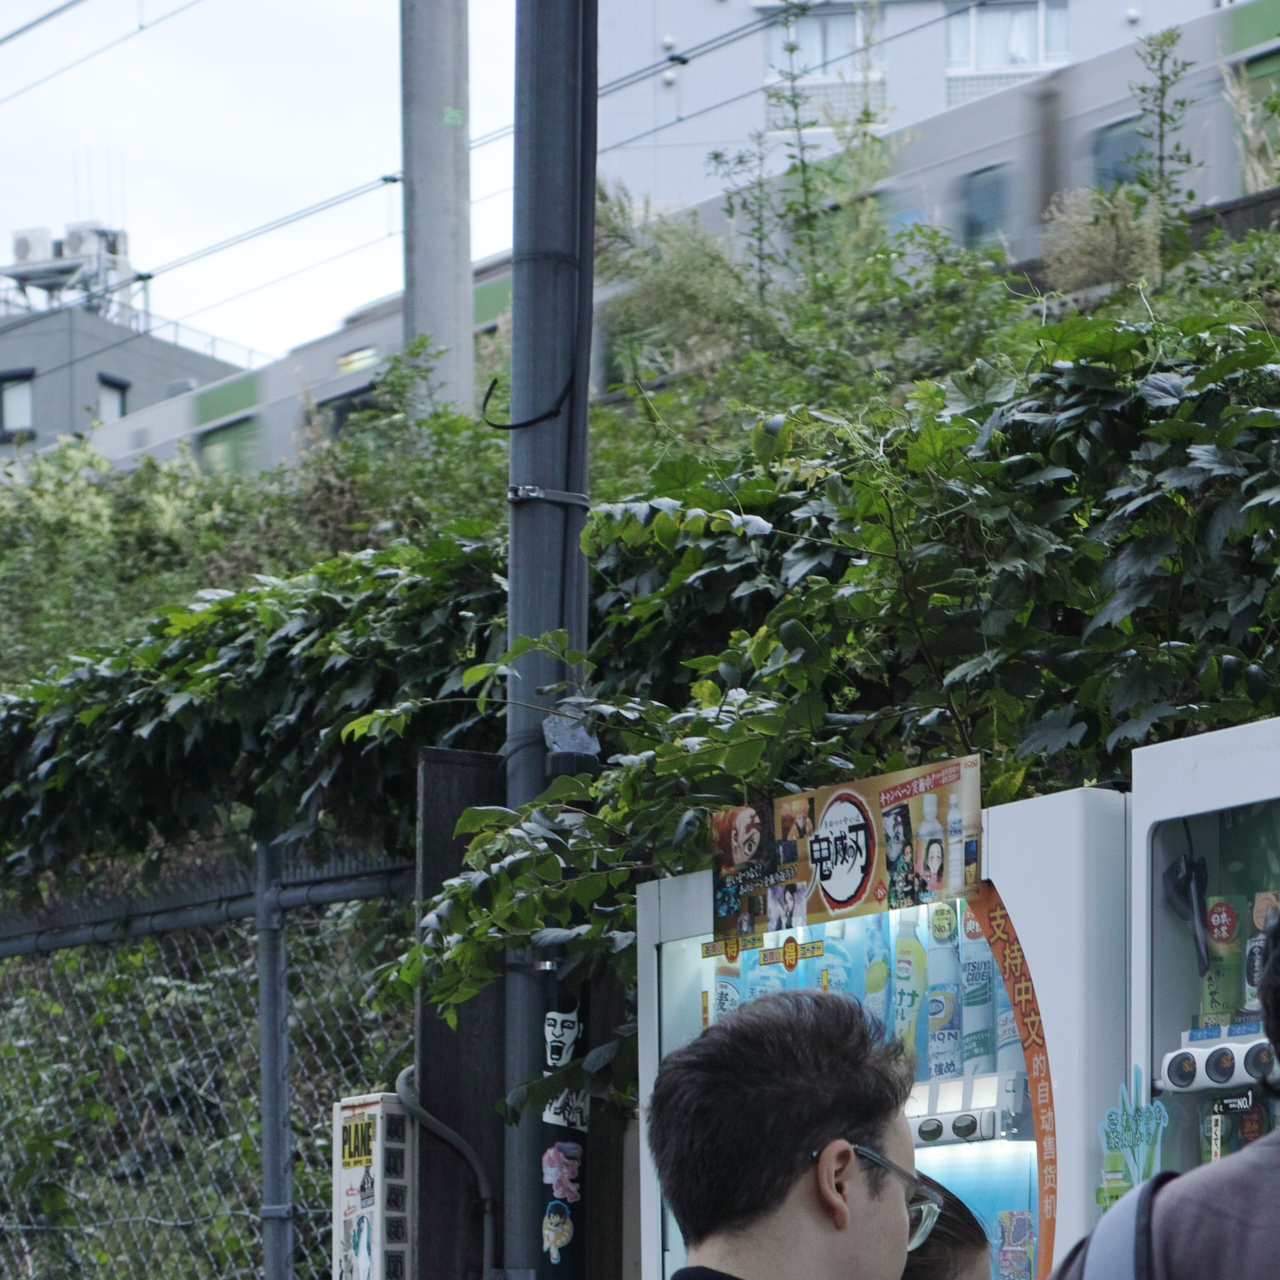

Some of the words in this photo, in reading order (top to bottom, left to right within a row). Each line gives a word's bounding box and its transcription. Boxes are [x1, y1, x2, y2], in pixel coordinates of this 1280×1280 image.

[880, 774, 935, 806] キャンペーン実施中!
[809, 822, 867, 881] 鬼滅の刃
[934, 922, 951, 933] No.1
[762, 938, 822, 971] お買い得コーナー
[342, 1121, 373, 1160] PLANE
